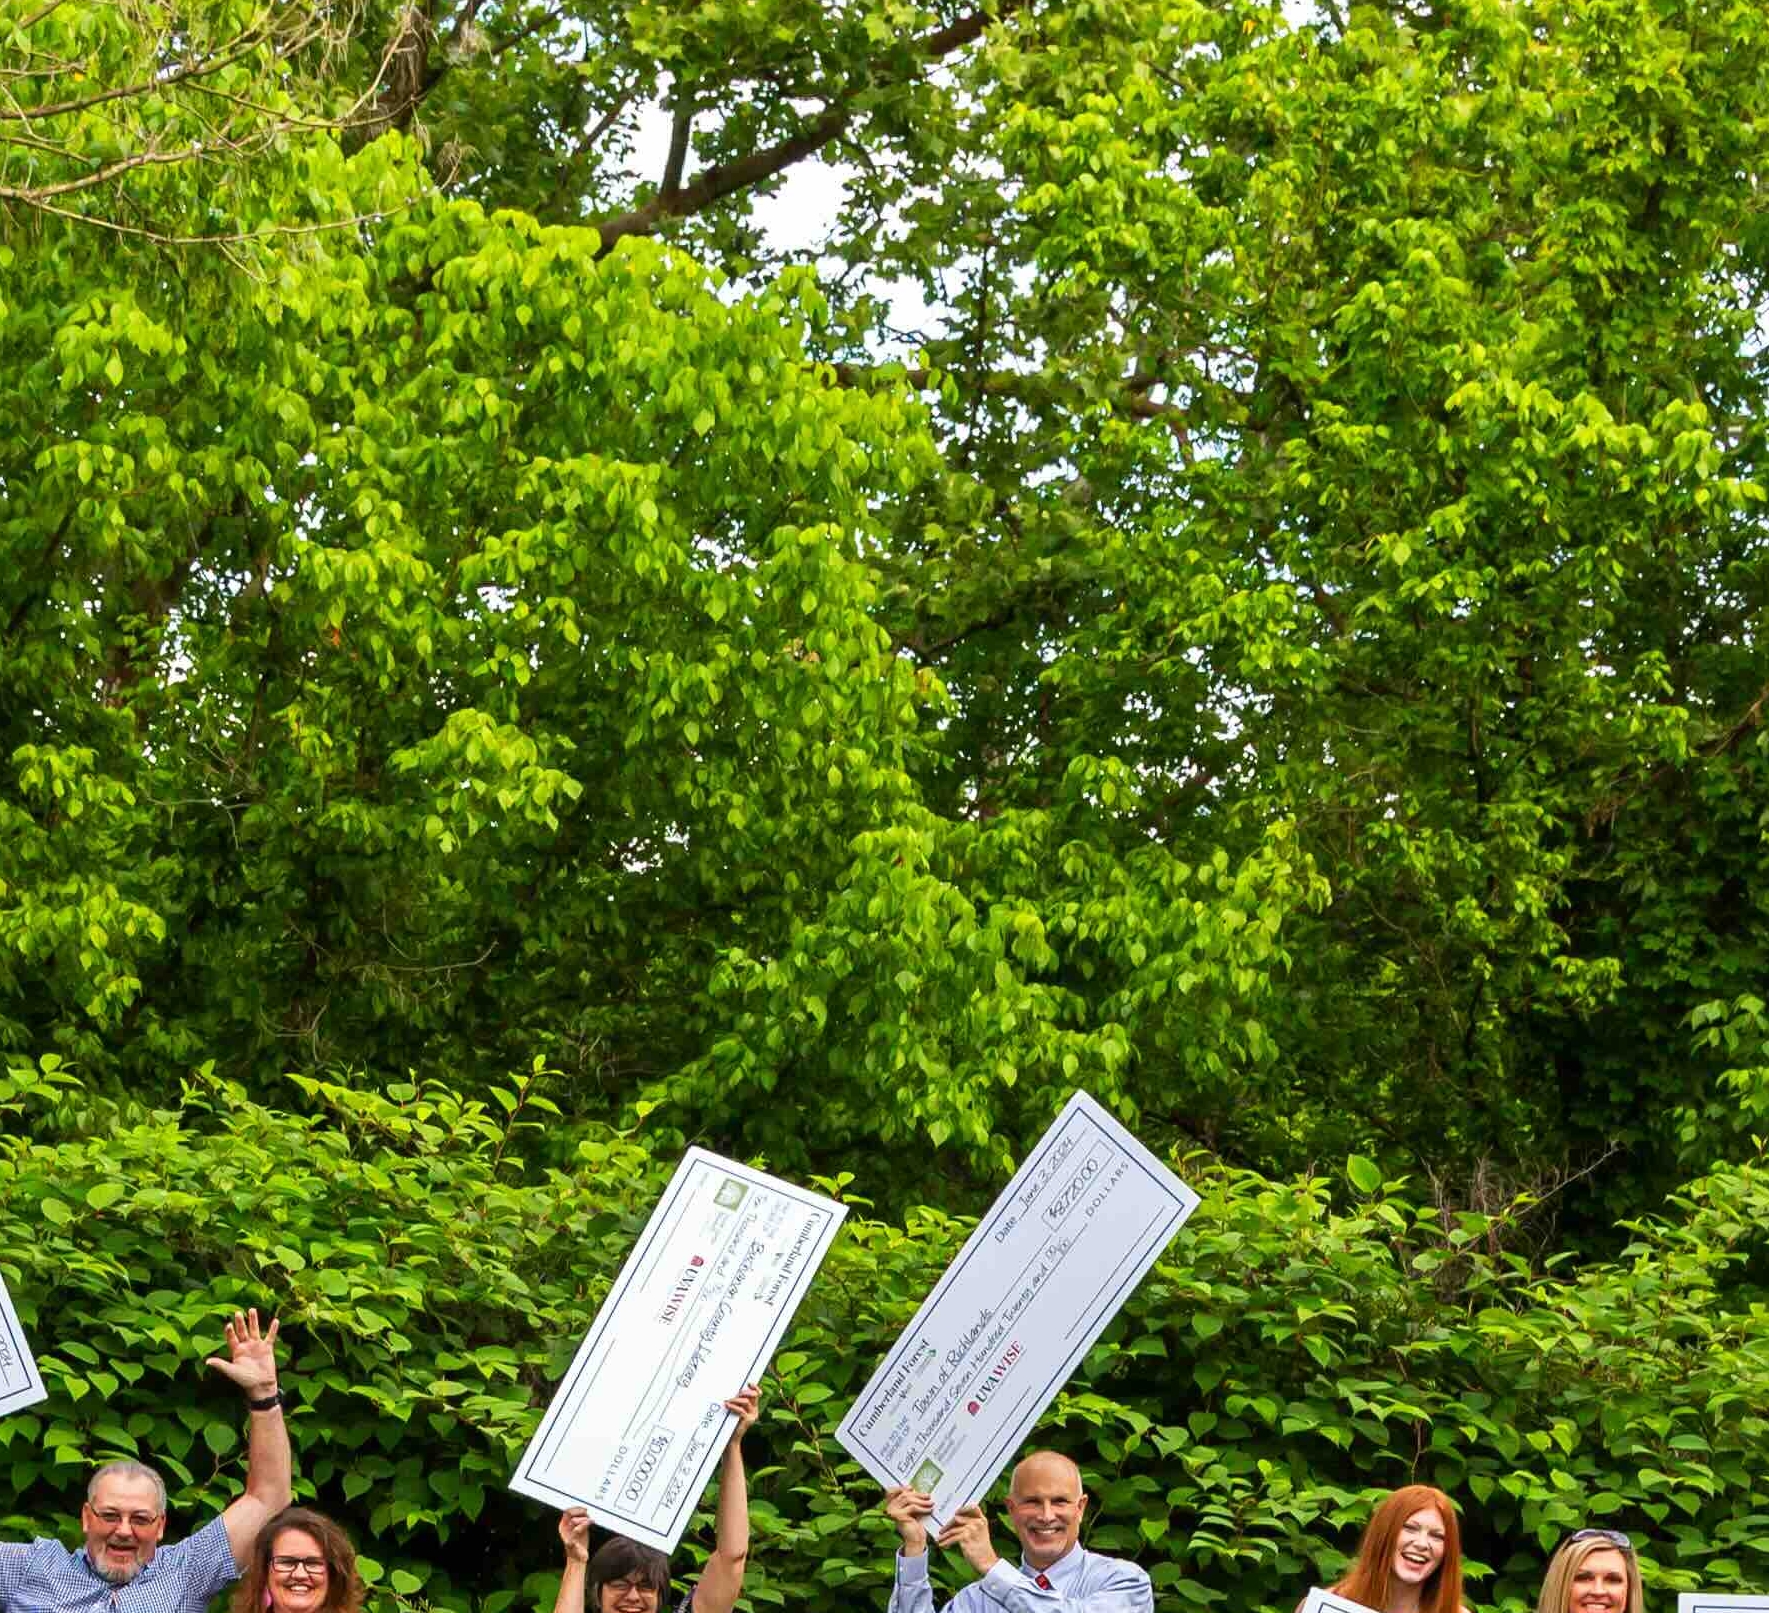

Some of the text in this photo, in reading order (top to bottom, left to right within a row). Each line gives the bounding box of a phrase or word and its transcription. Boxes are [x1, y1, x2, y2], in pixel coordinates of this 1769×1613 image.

[1017, 1182, 1041, 1212] June
[1085, 1161, 1128, 1217] DOLLARS
[781, 1212, 820, 1274] Cumberland
[994, 1215, 1017, 1243] Date
[764, 1274, 788, 1306] Forest
[857, 1371, 906, 1437] Cumberland
[902, 1338, 929, 1373] Forest
[896, 1446, 919, 1474] Eight
[914, 1397, 951, 1445] Thousand
[948, 1369, 973, 1399] Seven
[970, 1323, 1004, 1368] Hundred
[1001, 1286, 1034, 1324] Twenty
[1030, 1263, 1048, 1287] and
[911, 1382, 939, 1415] Town
[935, 1364, 949, 1383] of
[945, 1306, 993, 1367] Richlands
[700, 1402, 720, 1429] Date
[594, 1445, 628, 1500] DOLLARS
